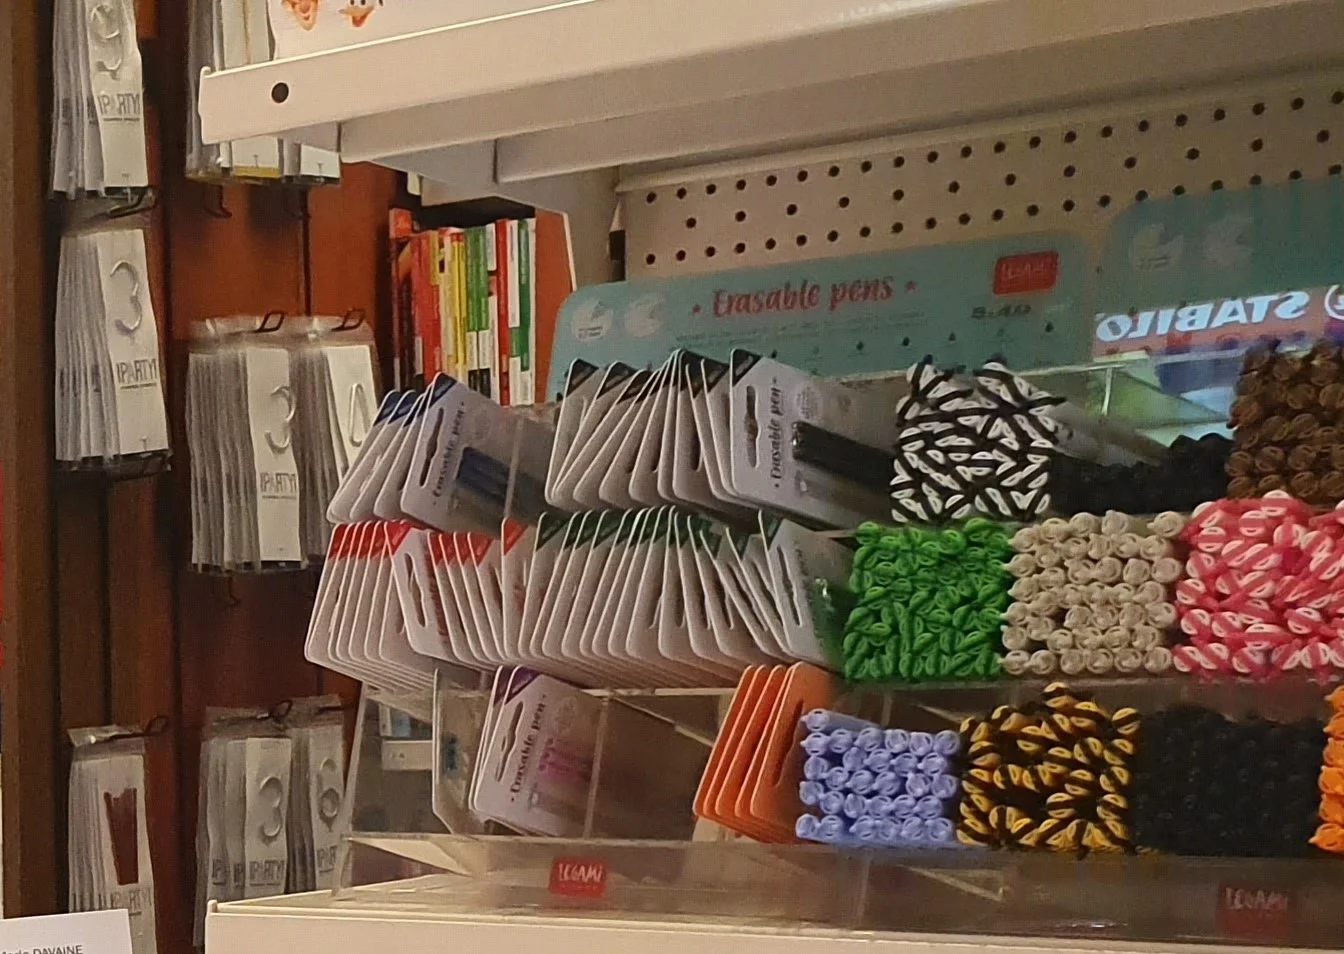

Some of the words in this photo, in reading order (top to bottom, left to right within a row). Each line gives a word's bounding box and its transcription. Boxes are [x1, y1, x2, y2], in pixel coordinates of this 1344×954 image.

[713, 279, 821, 318] Erasable
[830, 276, 895, 311] pens
[770, 386, 782, 422] pen
